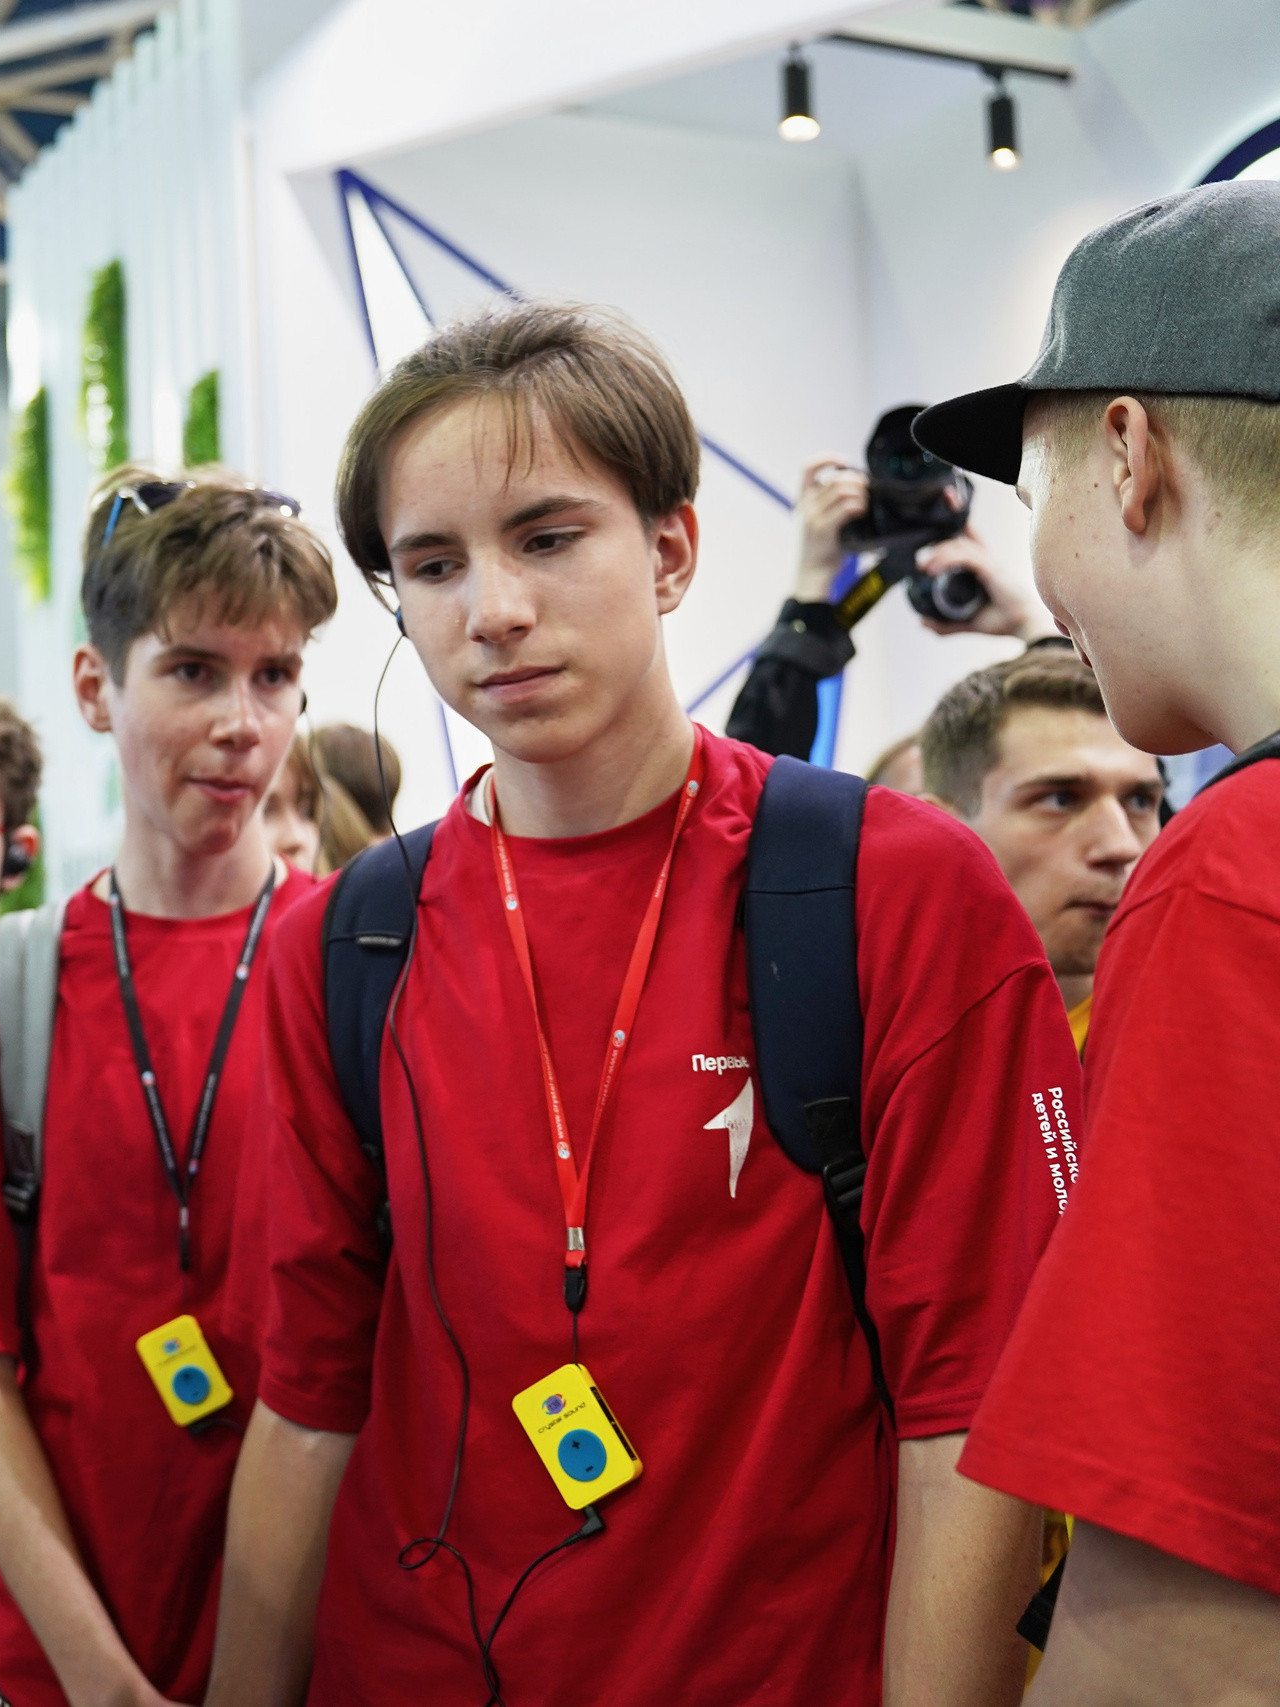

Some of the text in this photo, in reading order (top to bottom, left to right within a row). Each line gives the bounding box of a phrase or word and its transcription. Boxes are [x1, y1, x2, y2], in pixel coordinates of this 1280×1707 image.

[1032, 1092, 1068, 1216] детей и моло
